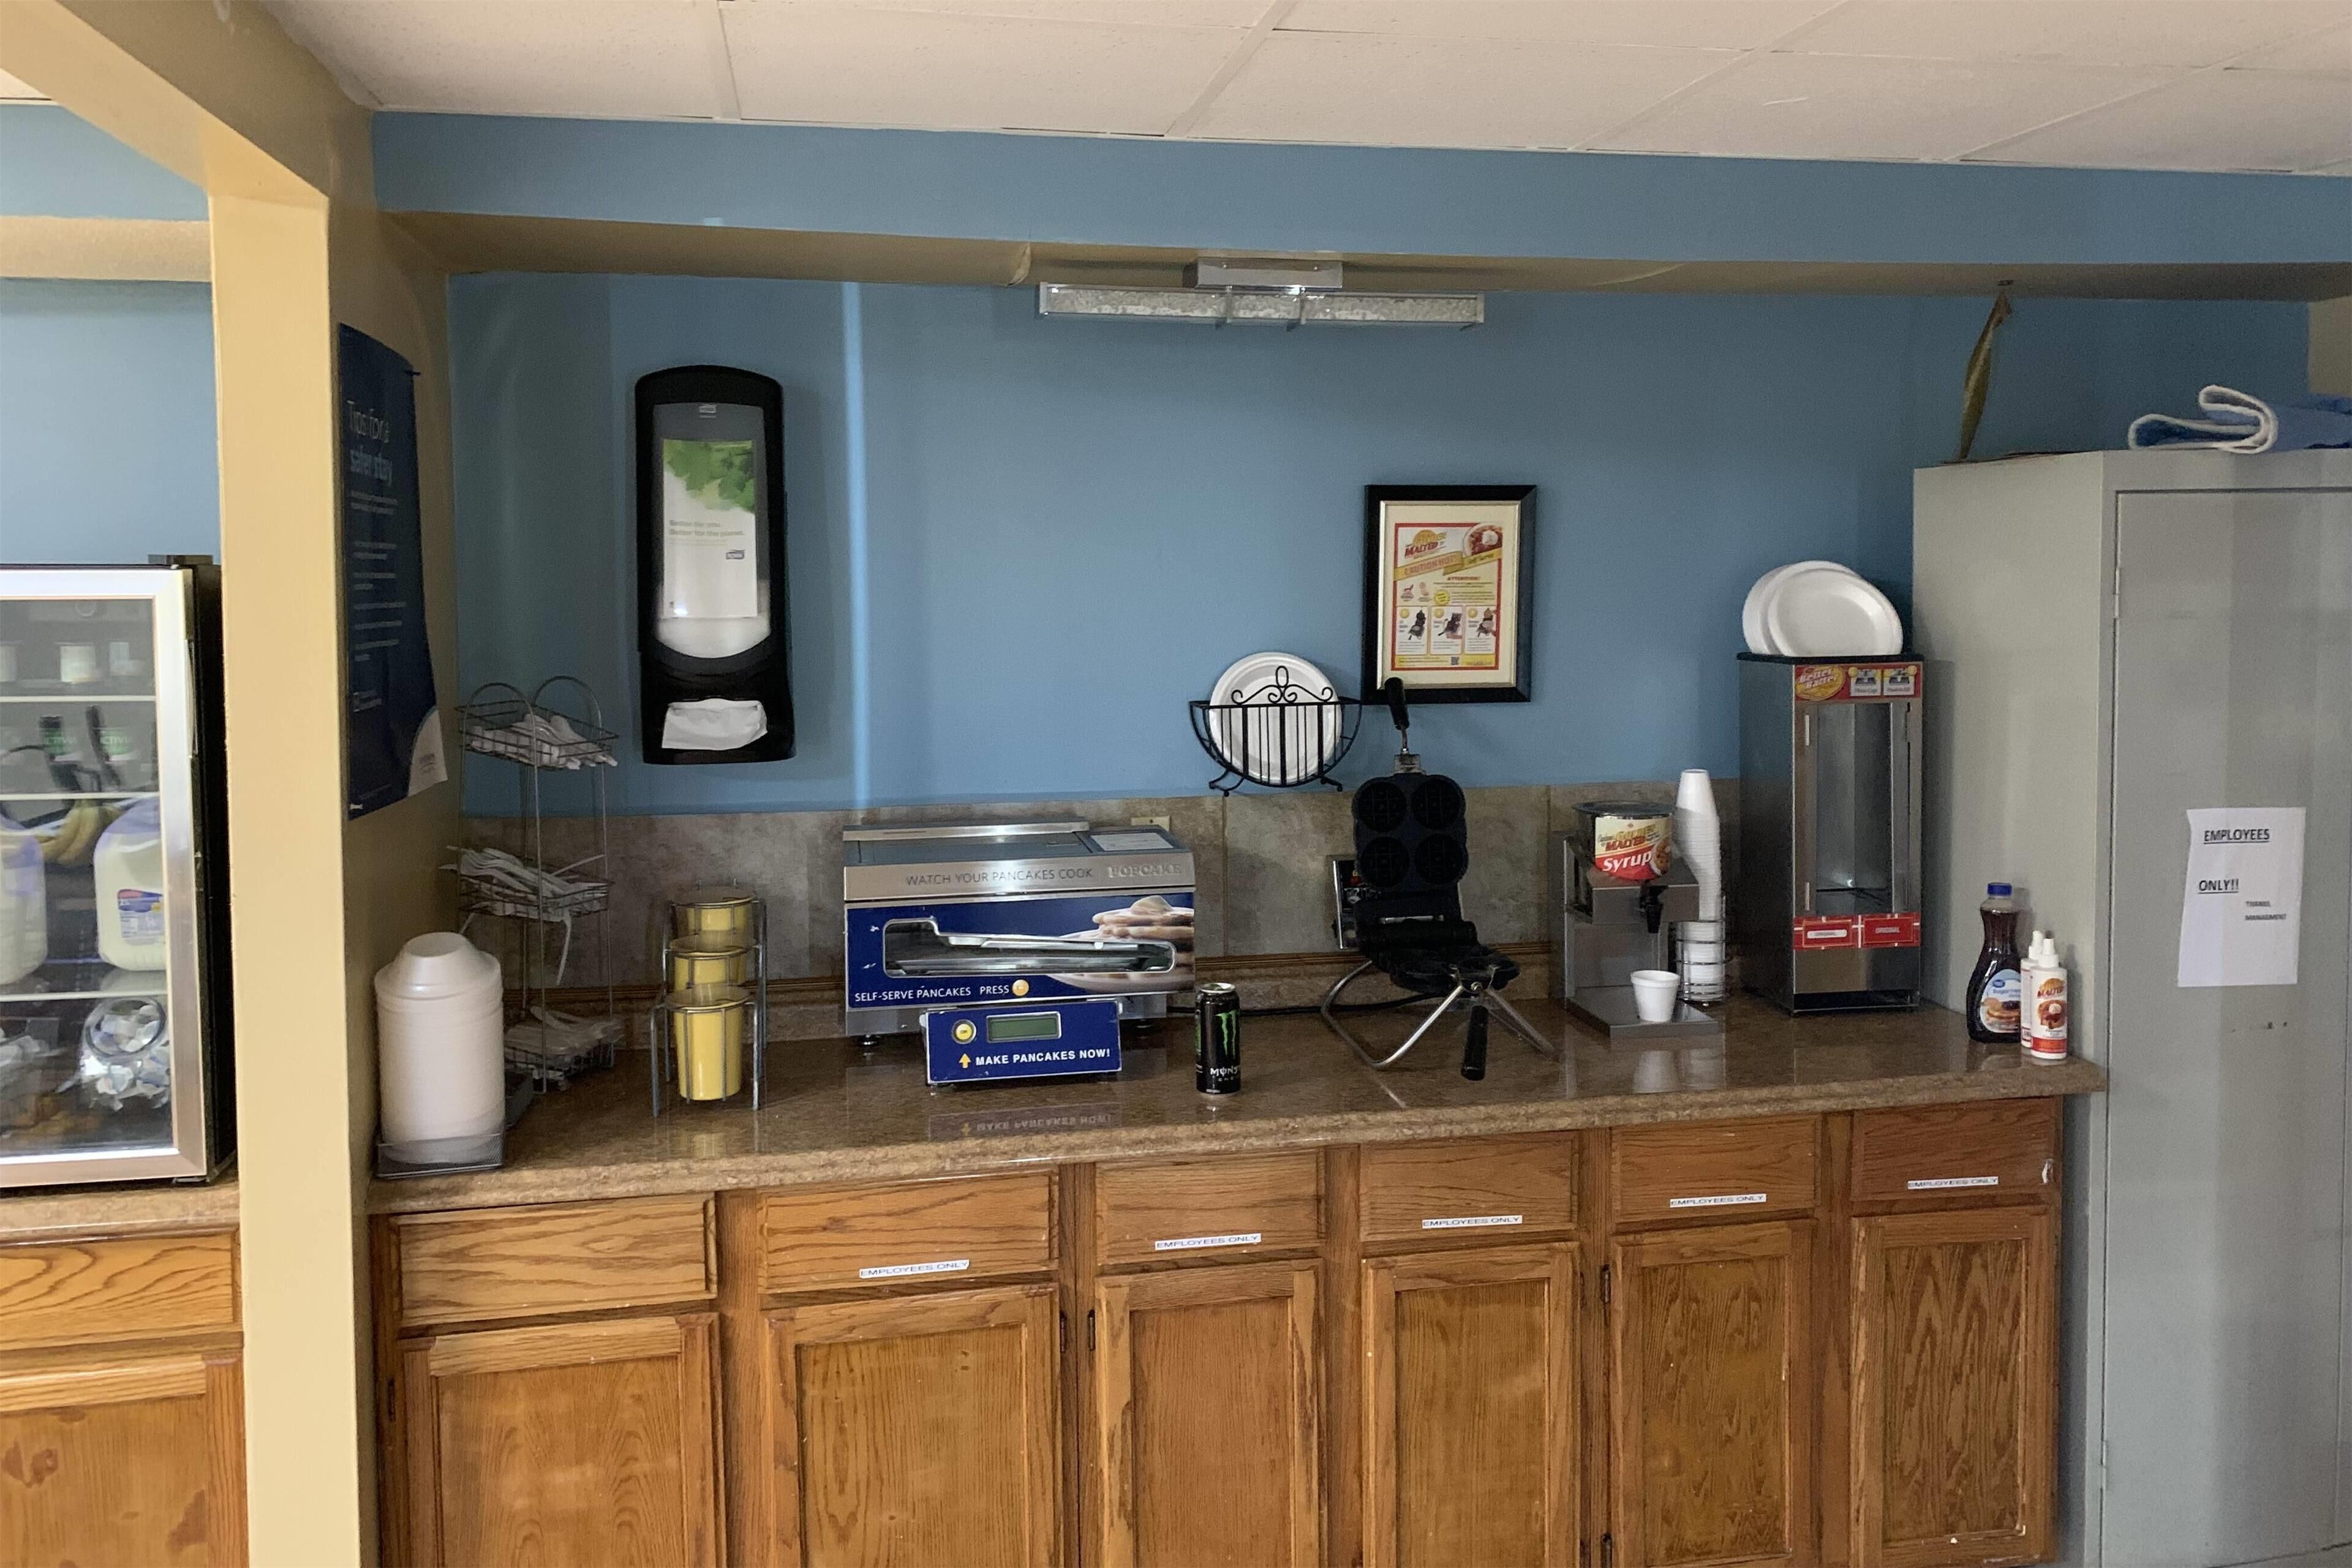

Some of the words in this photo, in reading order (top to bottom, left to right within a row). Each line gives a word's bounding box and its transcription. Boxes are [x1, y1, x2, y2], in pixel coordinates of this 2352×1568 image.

[350, 445, 372, 476] safer
[374, 453, 393, 487] stay
[1404, 559, 1438, 576] CAUTION
[1800, 668, 1833, 683] Better
[2204, 829, 2270, 842] EMPLOYEES
[1602, 851, 1652, 873] Syrup
[906, 873, 951, 886] WATCH
[955, 872, 989, 883] YOUR
[992, 869, 1055, 881] PANCAKES
[1058, 868, 1093, 880] COOK
[1107, 863, 1182, 878] POPCAKE
[2198, 878, 2239, 891] ONLY!!
[854, 990, 914, 1002] SELF-SERVE
[916, 987, 971, 998] PANCAKES
[980, 985, 1009, 995] PRESS
[976, 1054, 1009, 1066] MAKE
[1012, 1050, 1076, 1063] PANCAKES
[1080, 1048, 1110, 1059] NOW!
[1671, 1197, 1733, 1206] EMPLOYEES
[1423, 1218, 1488, 1227] EMPLOYEES
[1156, 1237, 1226, 1248] EMPLOYEES
[861, 1264, 933, 1276] EMPLOYEES
[937, 1261, 968, 1270] ONLY
